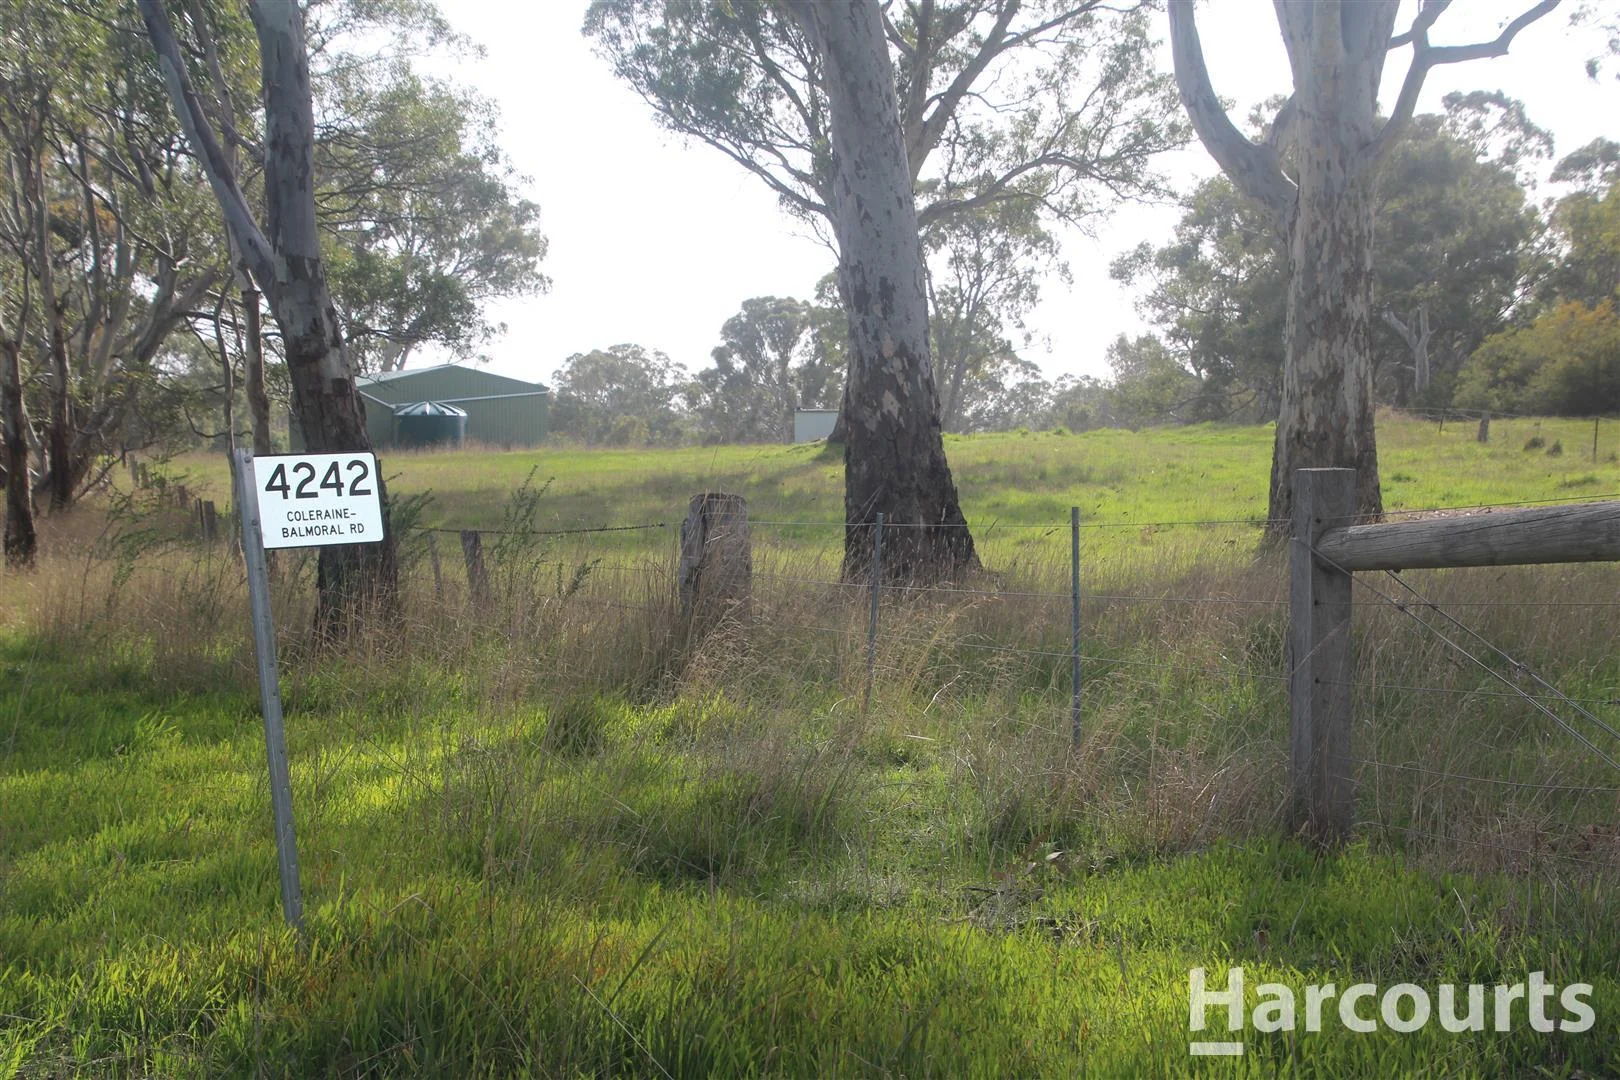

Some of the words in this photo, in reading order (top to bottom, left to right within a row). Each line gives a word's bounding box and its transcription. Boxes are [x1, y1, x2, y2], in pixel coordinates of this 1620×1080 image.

[265, 460, 372, 500] 4242
[286, 508, 357, 522] COLERAINE-
[281, 523, 345, 538] BALMORAL
[349, 523, 365, 534] RD
